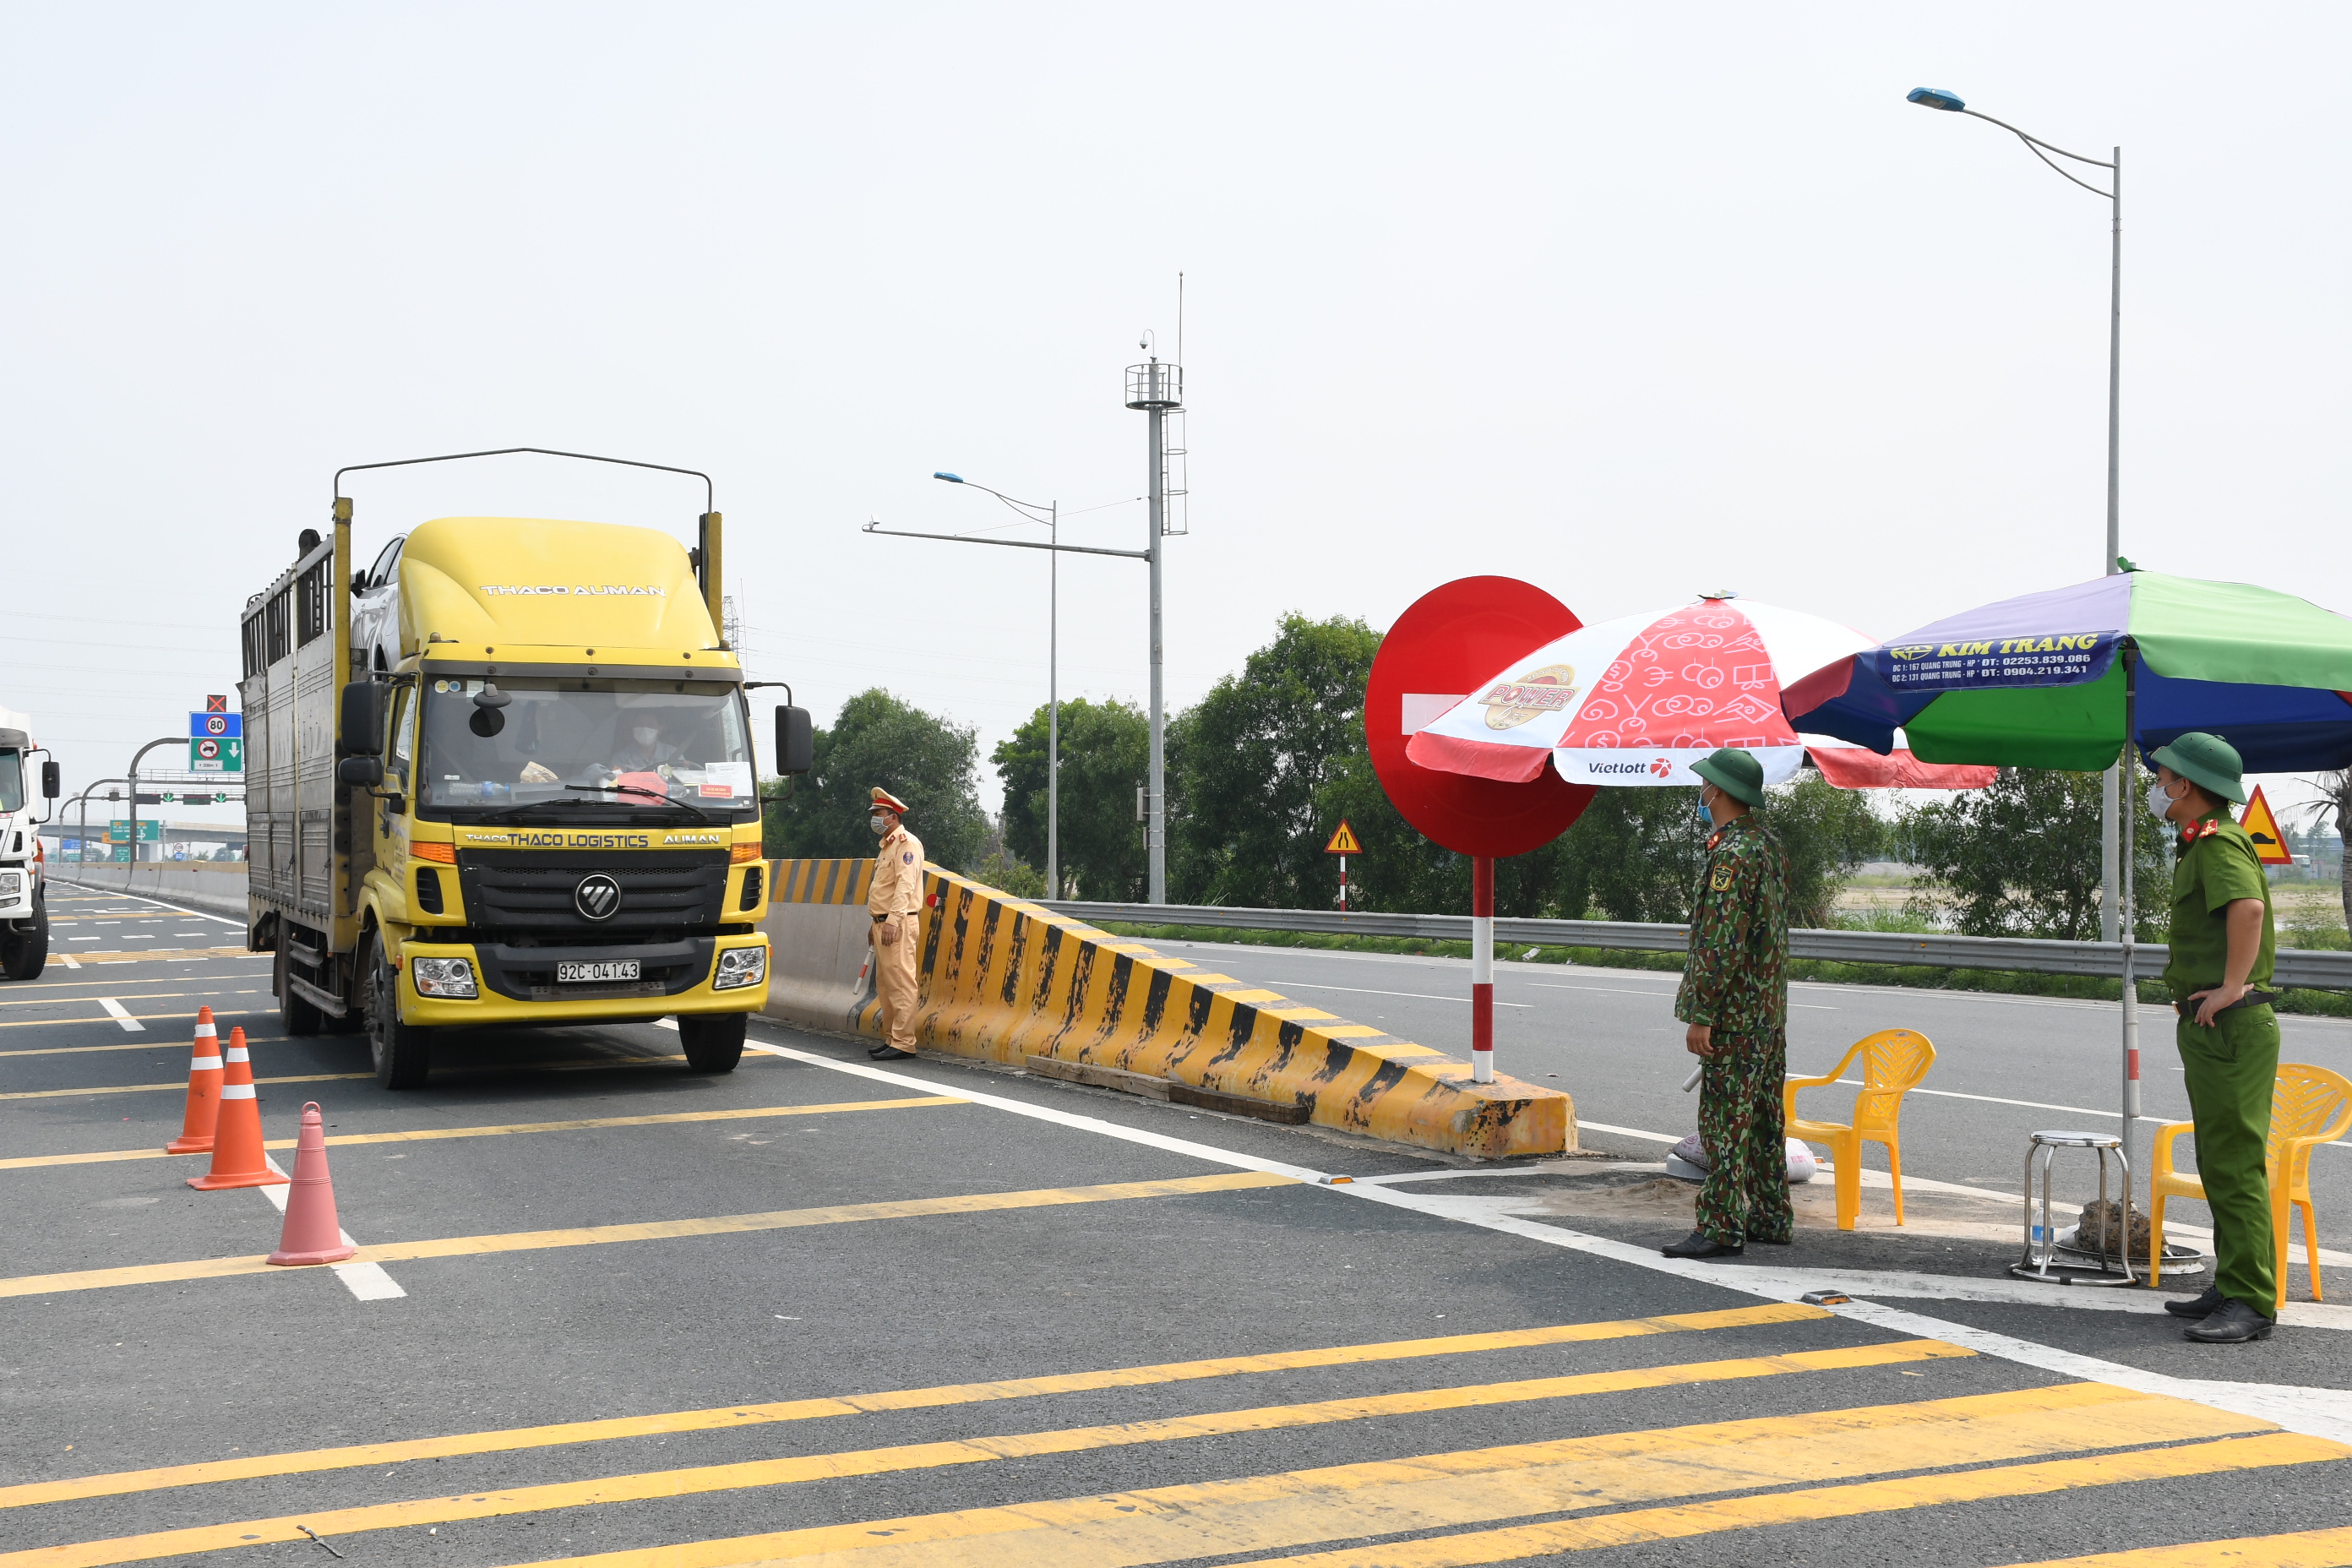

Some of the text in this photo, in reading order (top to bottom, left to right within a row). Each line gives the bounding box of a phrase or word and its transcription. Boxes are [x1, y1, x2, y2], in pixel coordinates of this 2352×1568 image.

[479, 585, 667, 597] THACO AUMAN
[1937, 634, 2099, 657] KIM TRANG
[1920, 662, 1941, 671] QUANG
[1942, 660, 1962, 668] TRUNG
[1981, 658, 2000, 667] ĐT:
[2002, 654, 2091, 666] 02253.839.086
[1892, 674, 1901, 683] ĐC
[1920, 672, 1941, 681] QUANG
[1942, 670, 1962, 679] TRUNG
[1981, 668, 2001, 677] ĐT:
[2003, 665, 2087, 676] 0904.219.341
[1484, 684, 1575, 708] POWER
[210, 720, 223, 730] 80
[1588, 762, 1647, 774] Vietlott
[466, 834, 509, 843] THACO
[507, 833, 649, 848] THACO LOGISTICS
[663, 835, 720, 846] AUMAN
[559, 963, 639, 980] 92C-041.43
